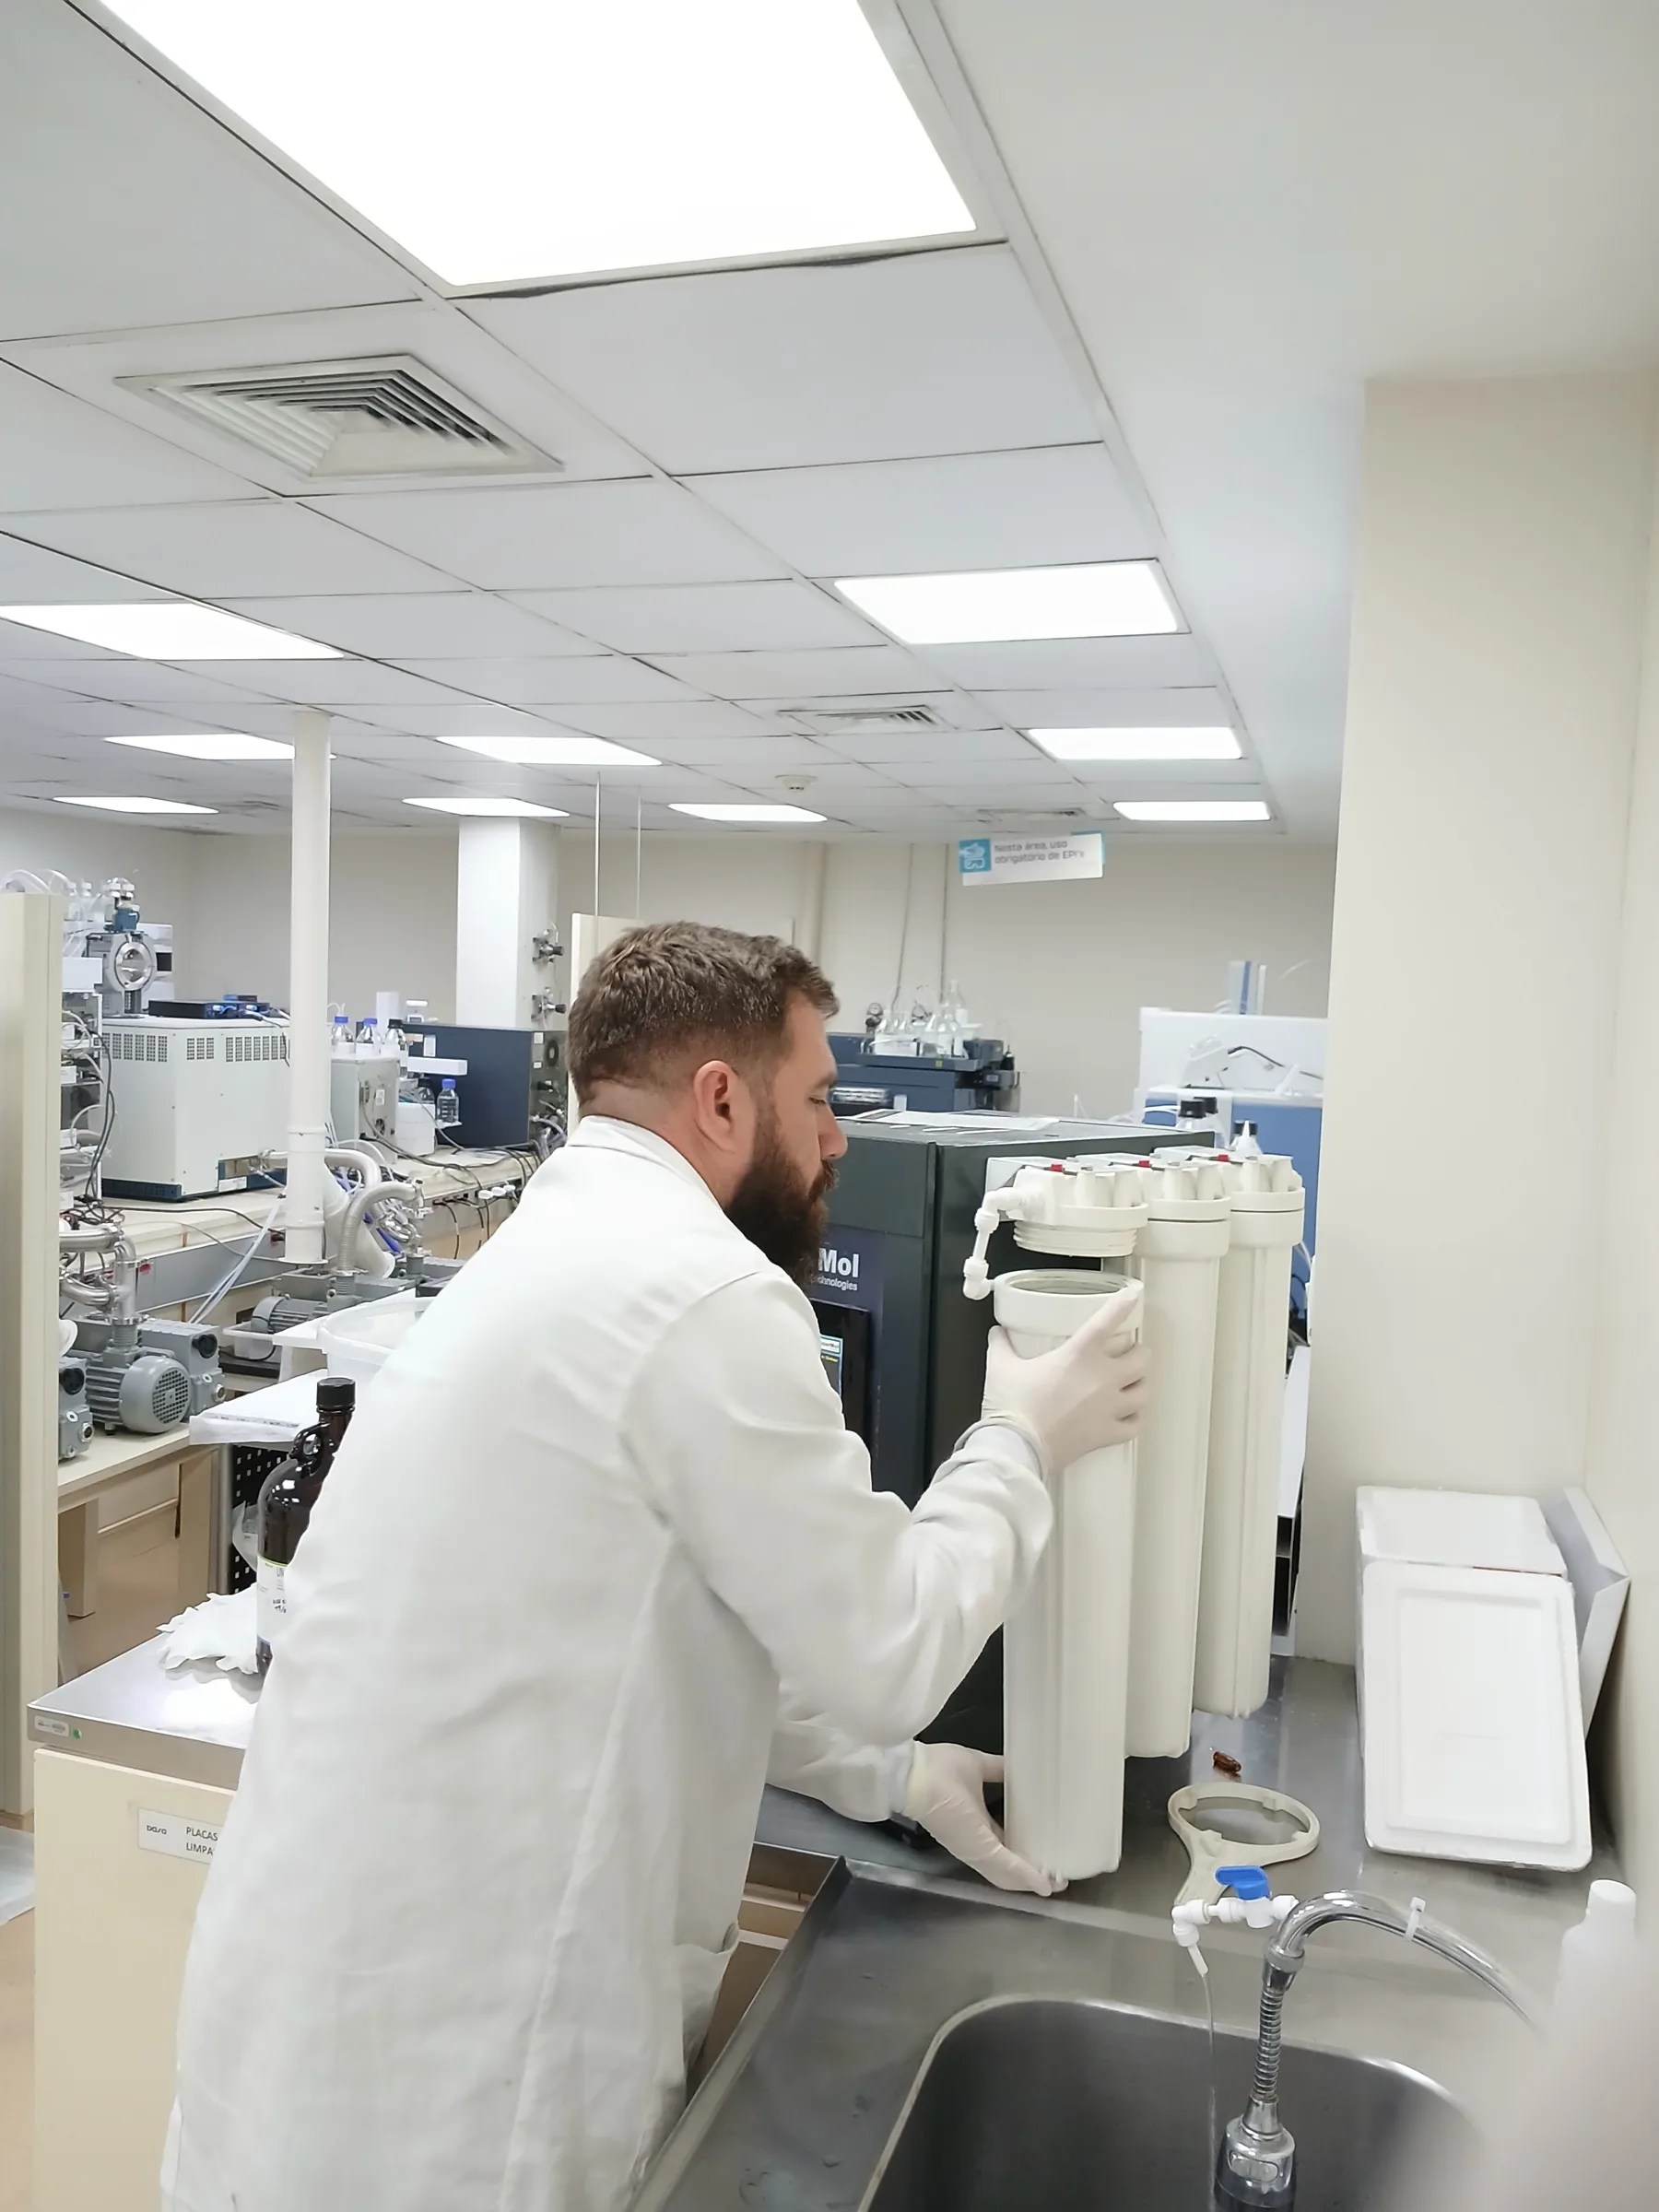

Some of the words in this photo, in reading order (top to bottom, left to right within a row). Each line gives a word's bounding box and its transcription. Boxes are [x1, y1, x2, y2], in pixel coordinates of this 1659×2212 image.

[994, 843, 1022, 853] Nesta
[1050, 840, 1067, 849] uso
[994, 852, 1045, 865] obrigatório
[1048, 852, 1060, 860] de
[818, 1247, 860, 1278] Mol
[185, 1826, 218, 1841] PLACAS
[185, 1842, 216, 1856] LIMPA
